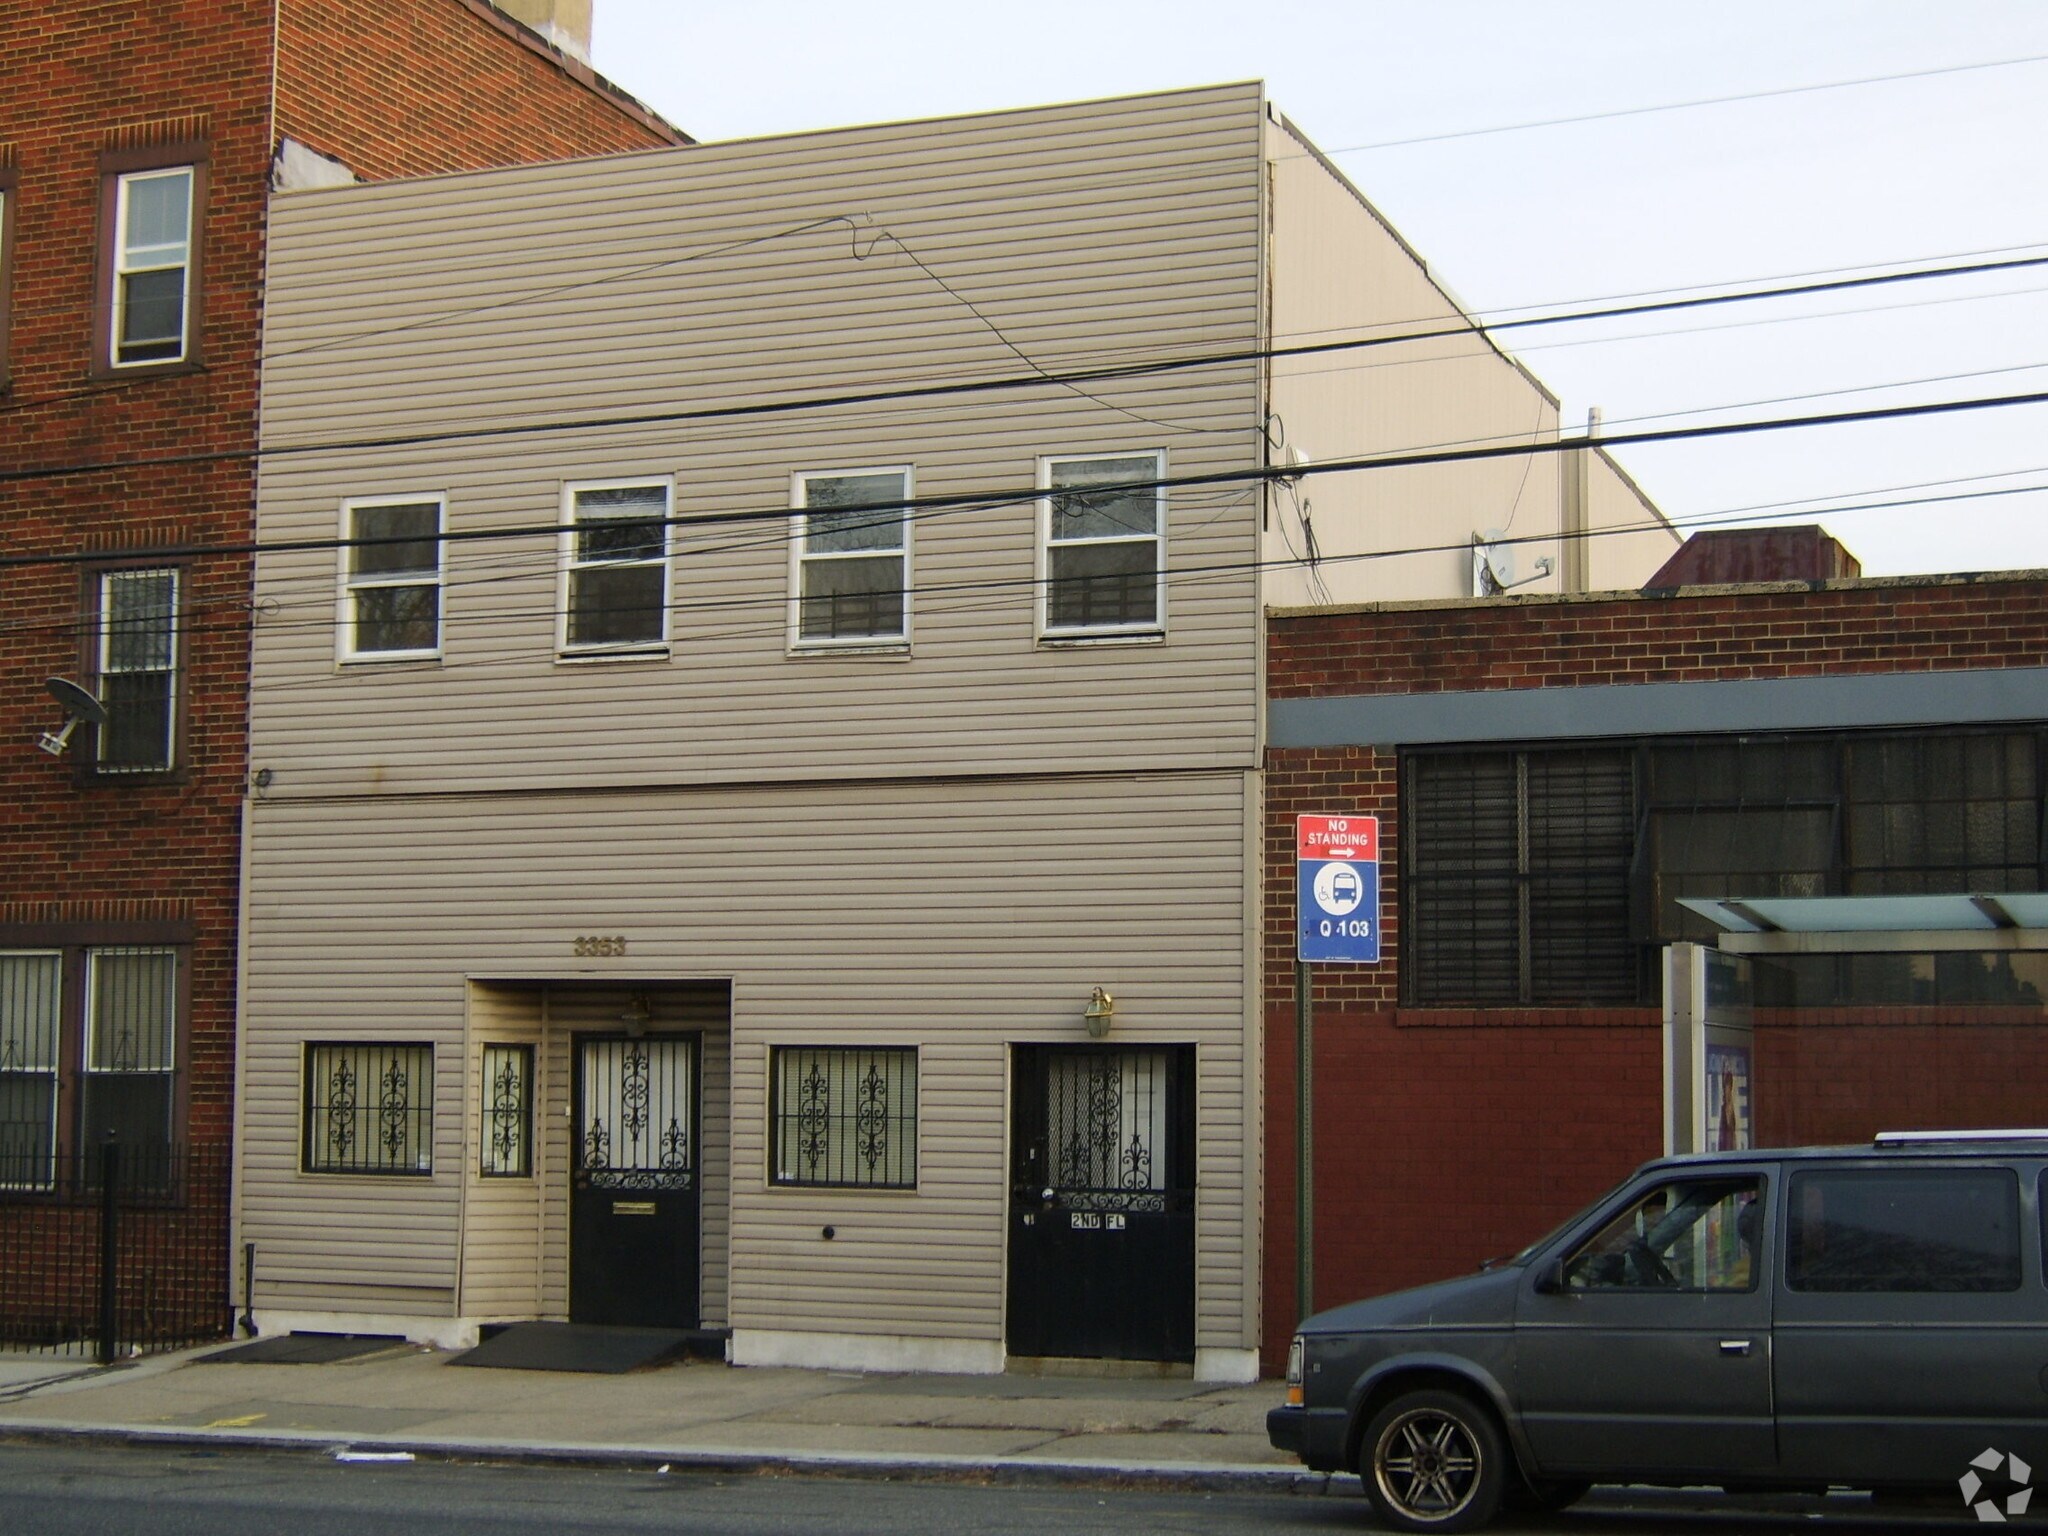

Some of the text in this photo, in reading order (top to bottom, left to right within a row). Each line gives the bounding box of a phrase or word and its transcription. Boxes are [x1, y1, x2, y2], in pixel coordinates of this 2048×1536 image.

[1328, 820, 1347, 832] NO
[1308, 832, 1368, 846] STANDING
[574, 936, 625, 957] 3353
[1072, 1214, 1124, 1229] 2ND FL
